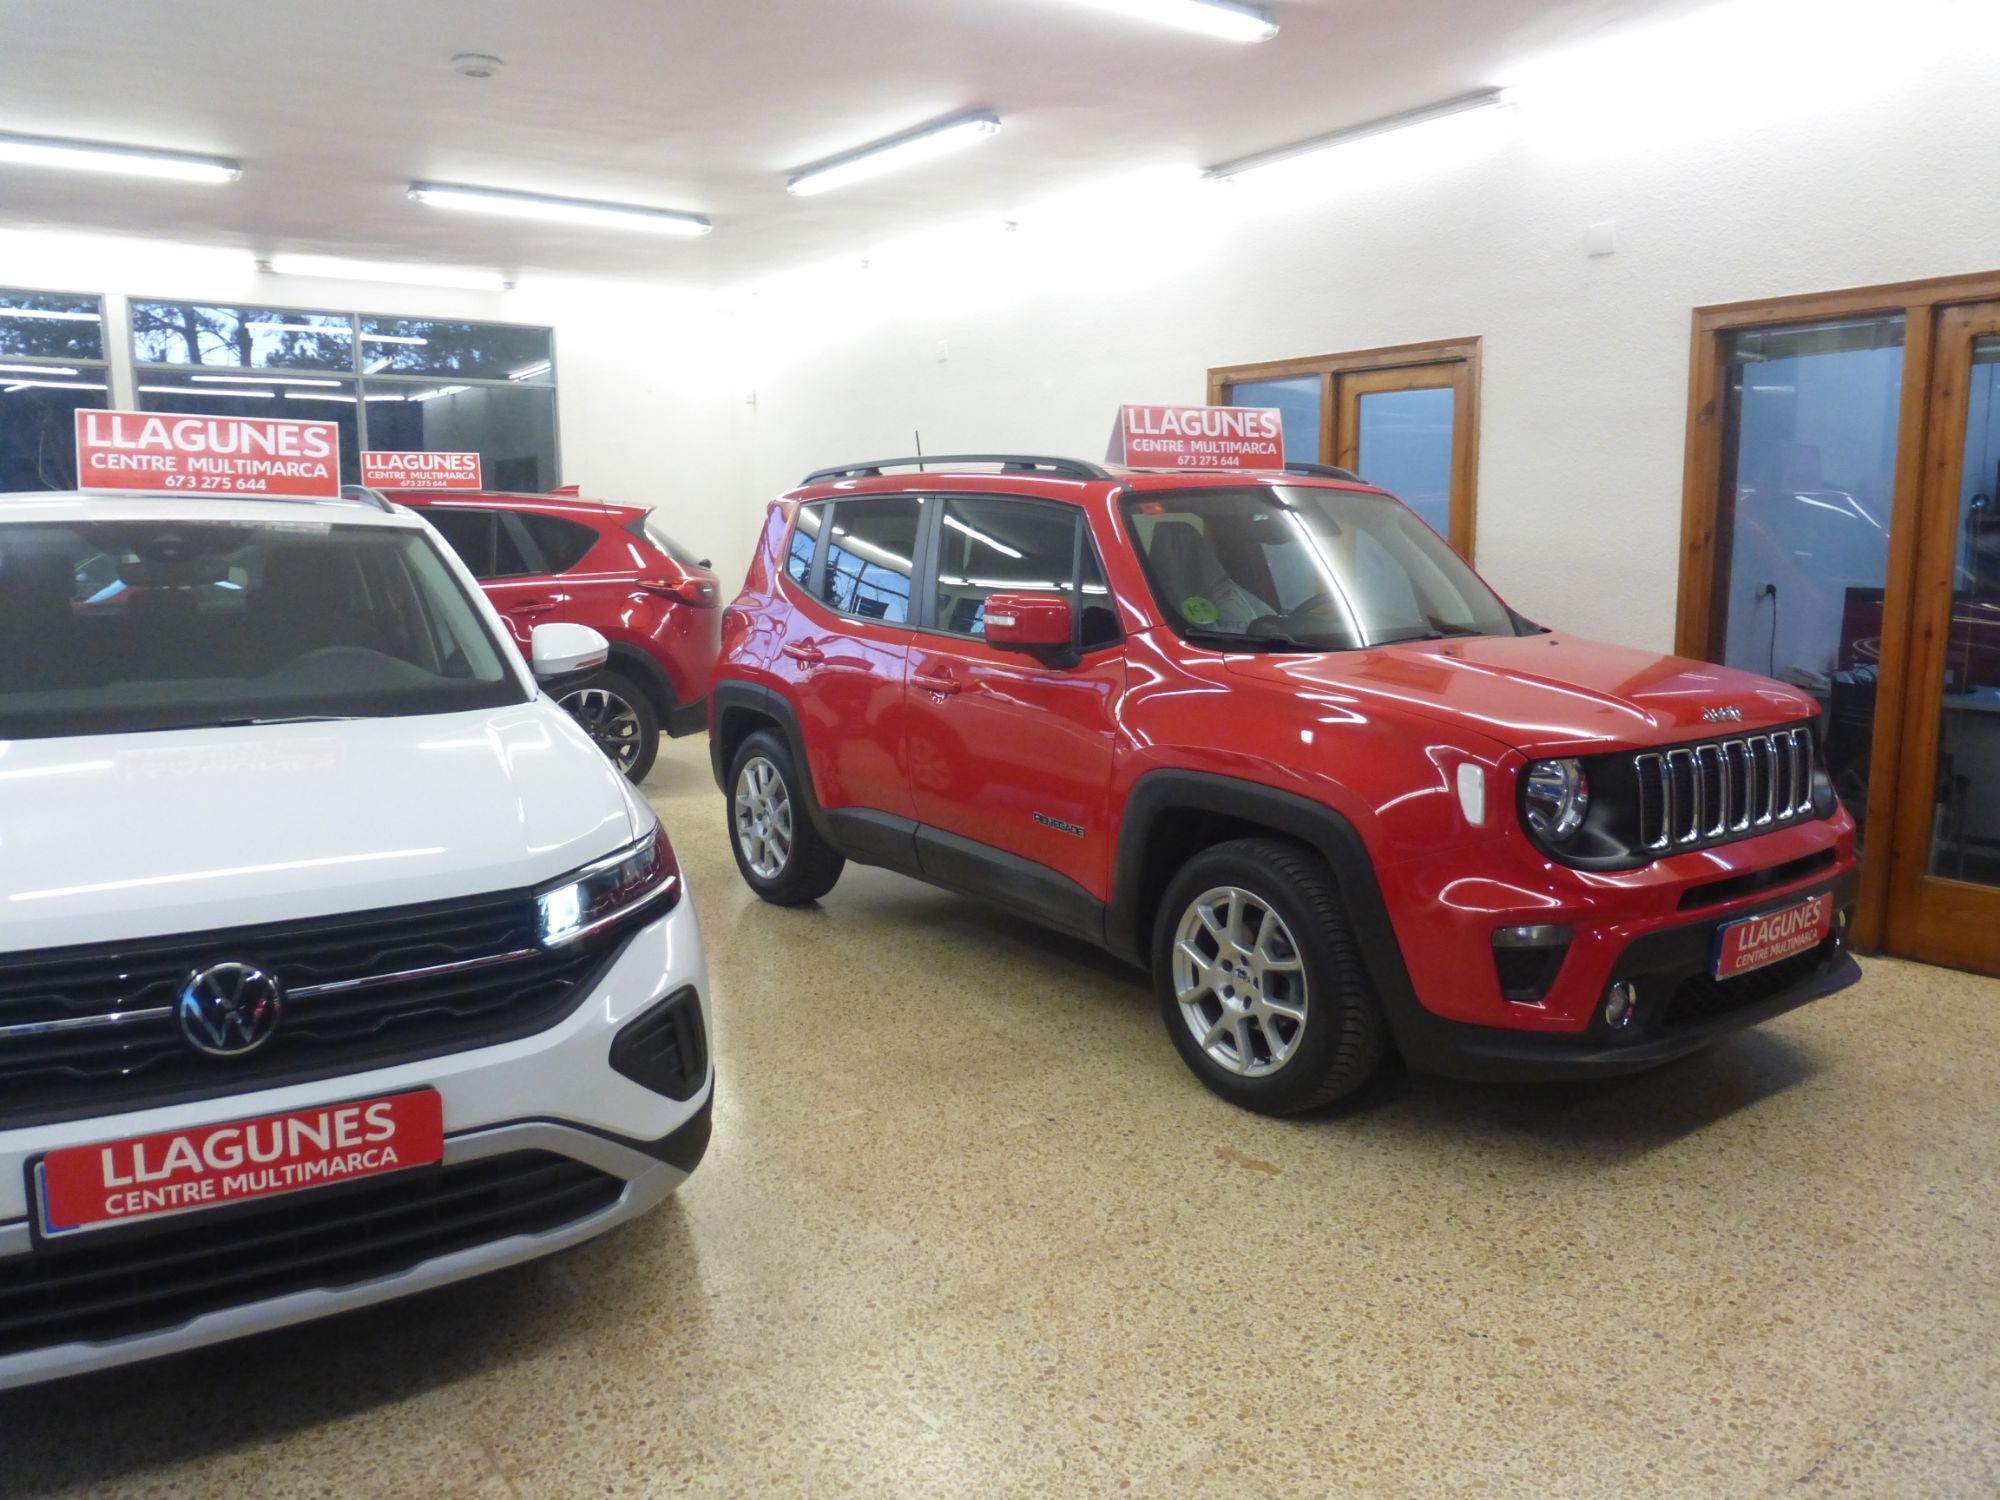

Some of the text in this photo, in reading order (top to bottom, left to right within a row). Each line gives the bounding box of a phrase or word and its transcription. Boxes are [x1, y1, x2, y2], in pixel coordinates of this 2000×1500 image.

[86, 414, 330, 458] LLAGUNES
[1128, 408, 1278, 439] LLAGUNES
[1132, 439, 1277, 455] CENTRE MULTIMARCA
[1177, 456, 1239, 466] 673 275 644
[91, 453, 329, 478] CENTRE MULTIMARCA
[365, 454, 476, 470] LLAGUNES
[367, 471, 476, 480] CENTRE MULTIMARCA
[165, 475, 266, 491] 673 275 644
[1738, 900, 1821, 951] LLAGUNES
[1736, 928, 1818, 968] CENTRE MULTIMARCA
[101, 1102, 396, 1188] LLAGUNES
[105, 1146, 398, 1215] CENTRE MULTIMARCA
